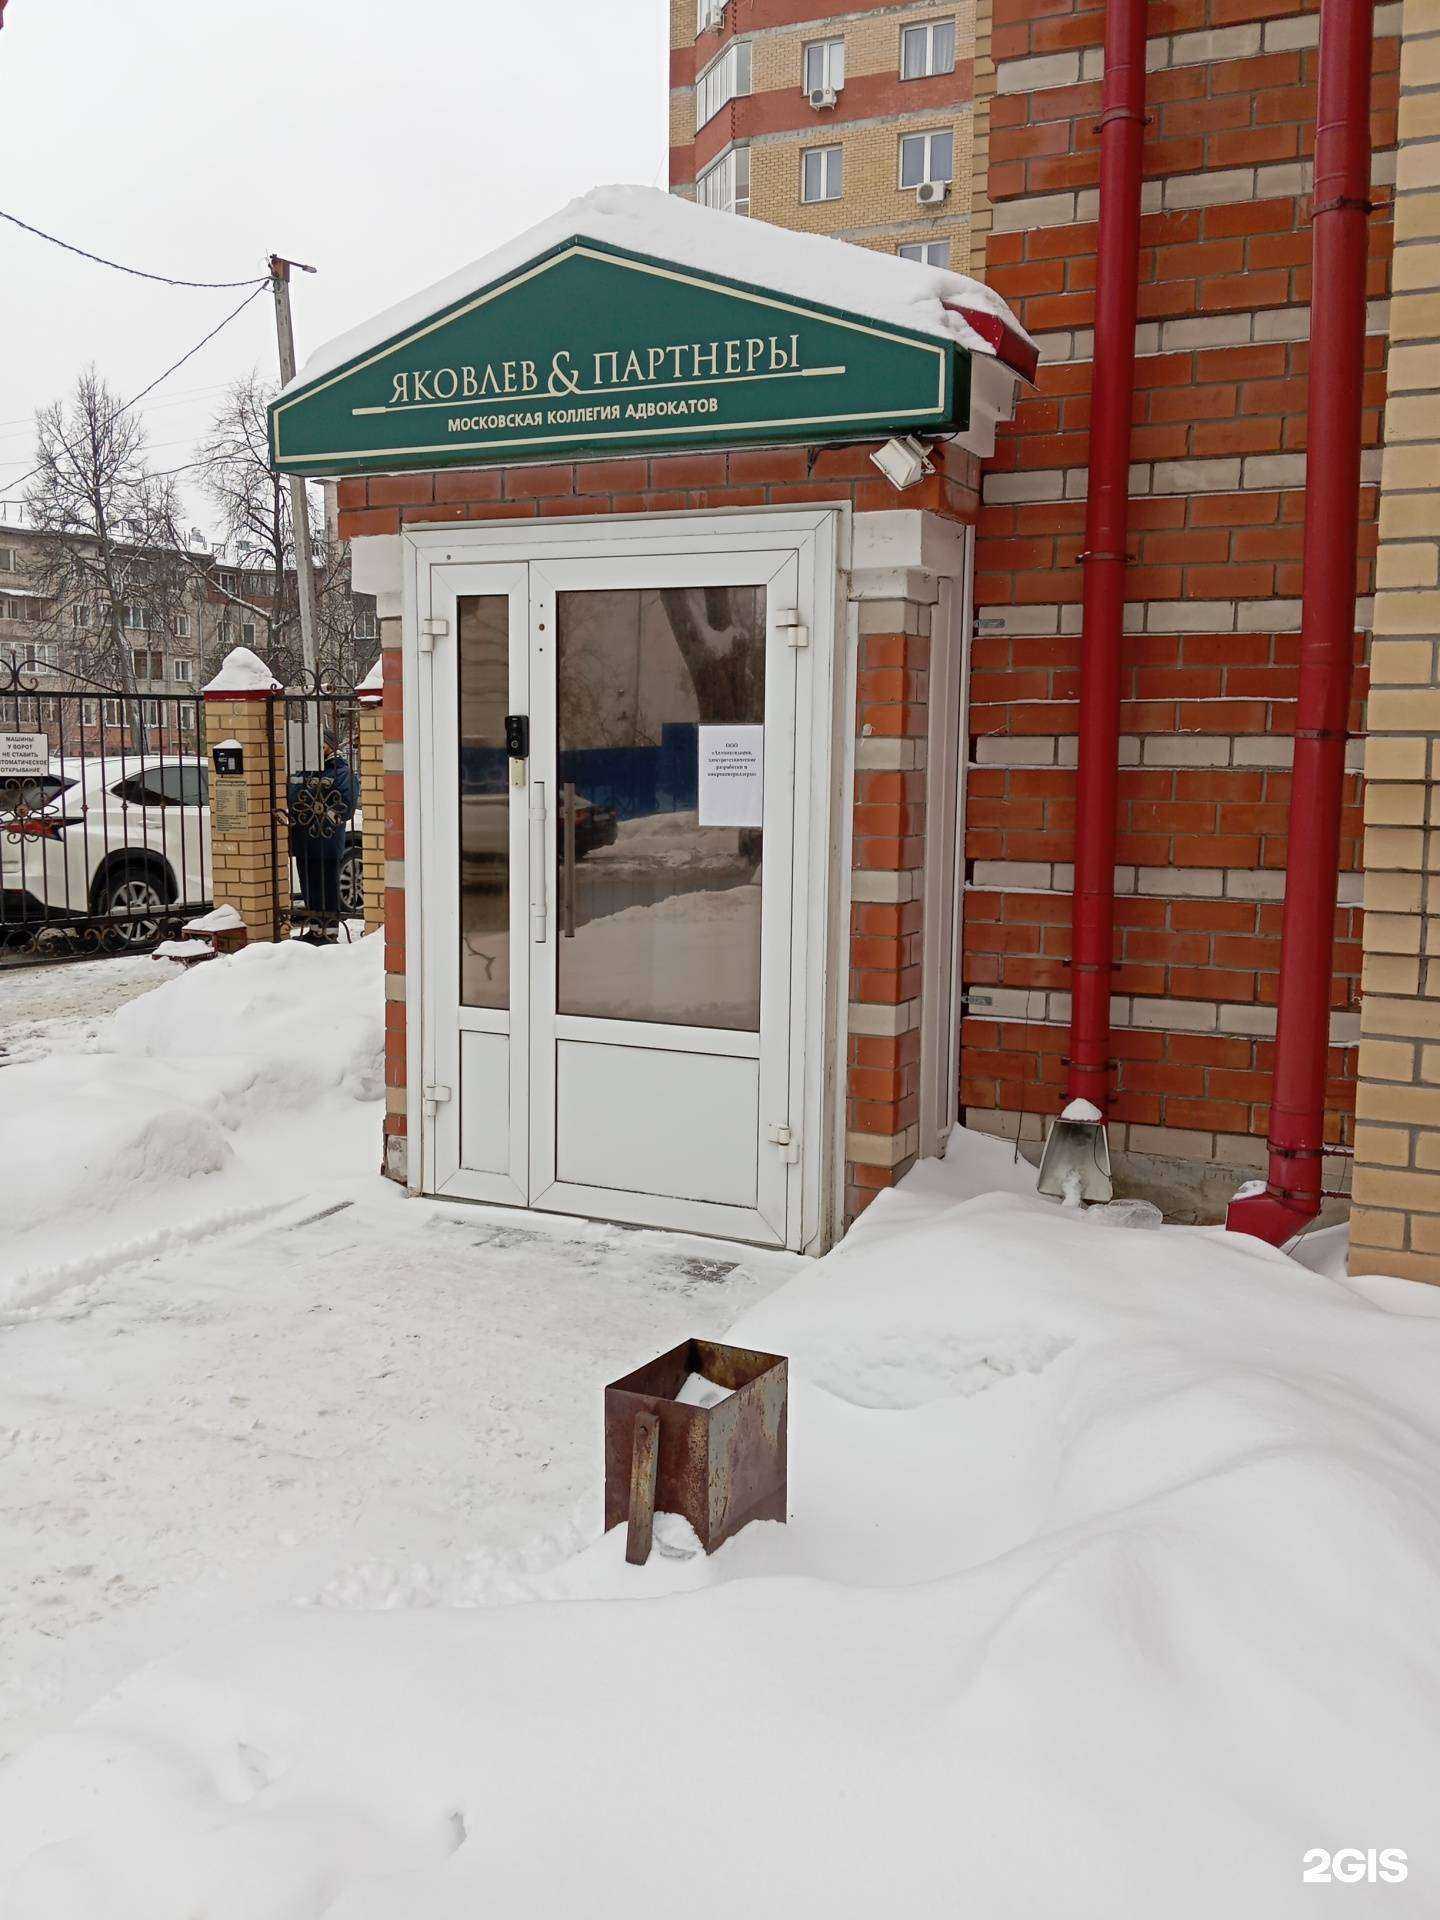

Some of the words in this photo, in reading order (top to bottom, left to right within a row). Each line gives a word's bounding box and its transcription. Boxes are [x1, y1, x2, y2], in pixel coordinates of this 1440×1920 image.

[389, 360, 538, 403] ЯКОВЛЕВ
[547, 351, 581, 396] &
[593, 334, 800, 384] ПАРТНЕРЫ
[448, 412, 542, 432] МОСКОВСКАЯ
[547, 405, 620, 424] КОЛЛЕГИЯ
[625, 397, 718, 420] АДВОКАТОВ
